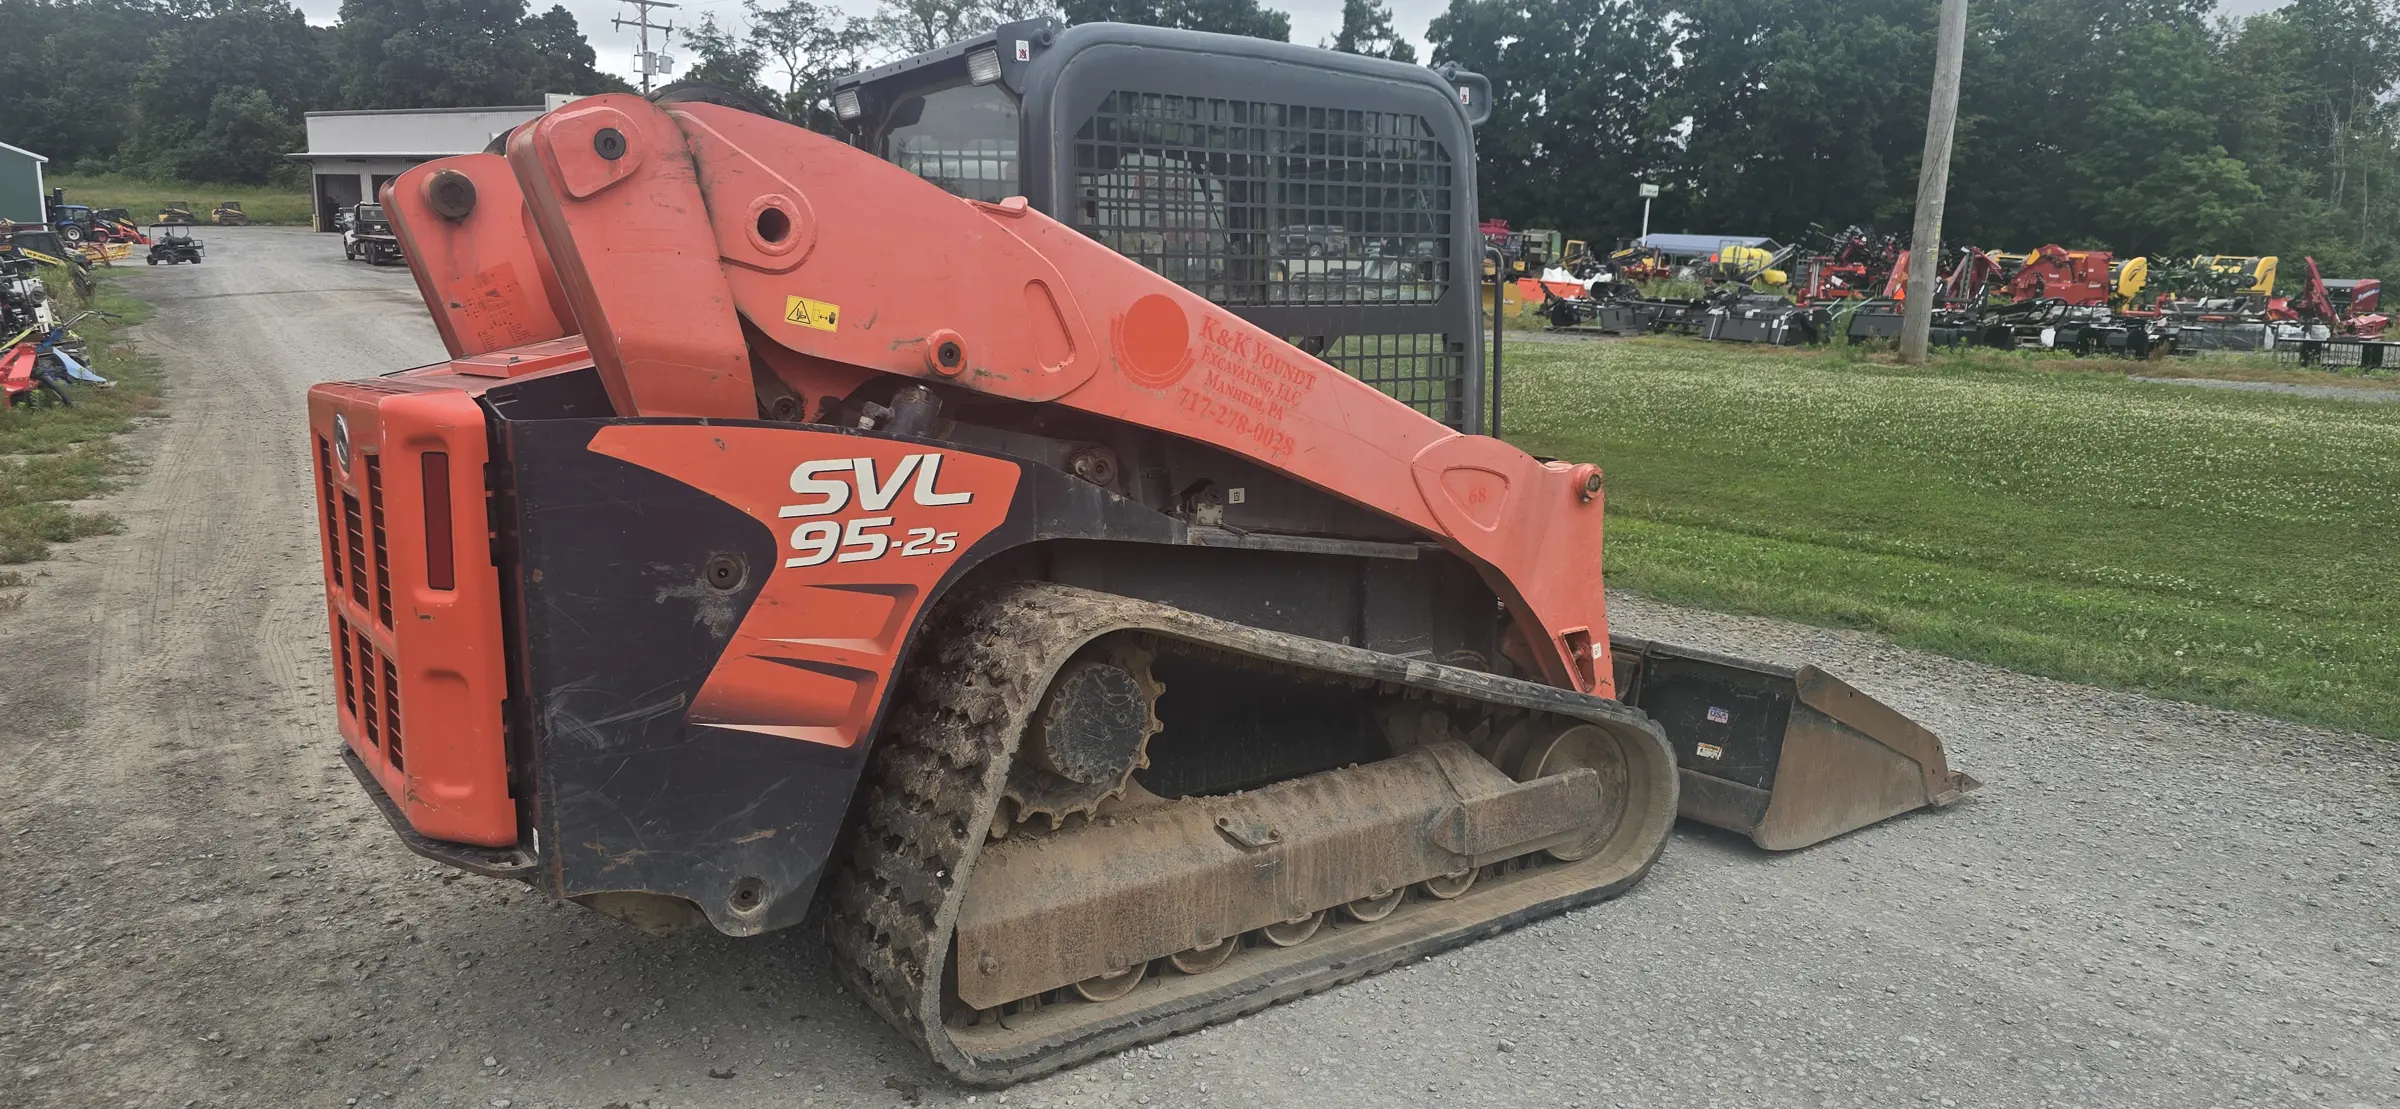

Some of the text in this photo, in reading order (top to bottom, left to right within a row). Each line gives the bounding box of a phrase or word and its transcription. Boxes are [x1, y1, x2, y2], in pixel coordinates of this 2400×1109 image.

[1199, 315, 1316, 391] K&K YOUNDT
[1201, 346, 1303, 407] EXCAVATING, LLC
[1204, 369, 1284, 421] MANHEIM, PA
[778, 453, 973, 518] SVL
[1469, 487, 1487, 504] 68
